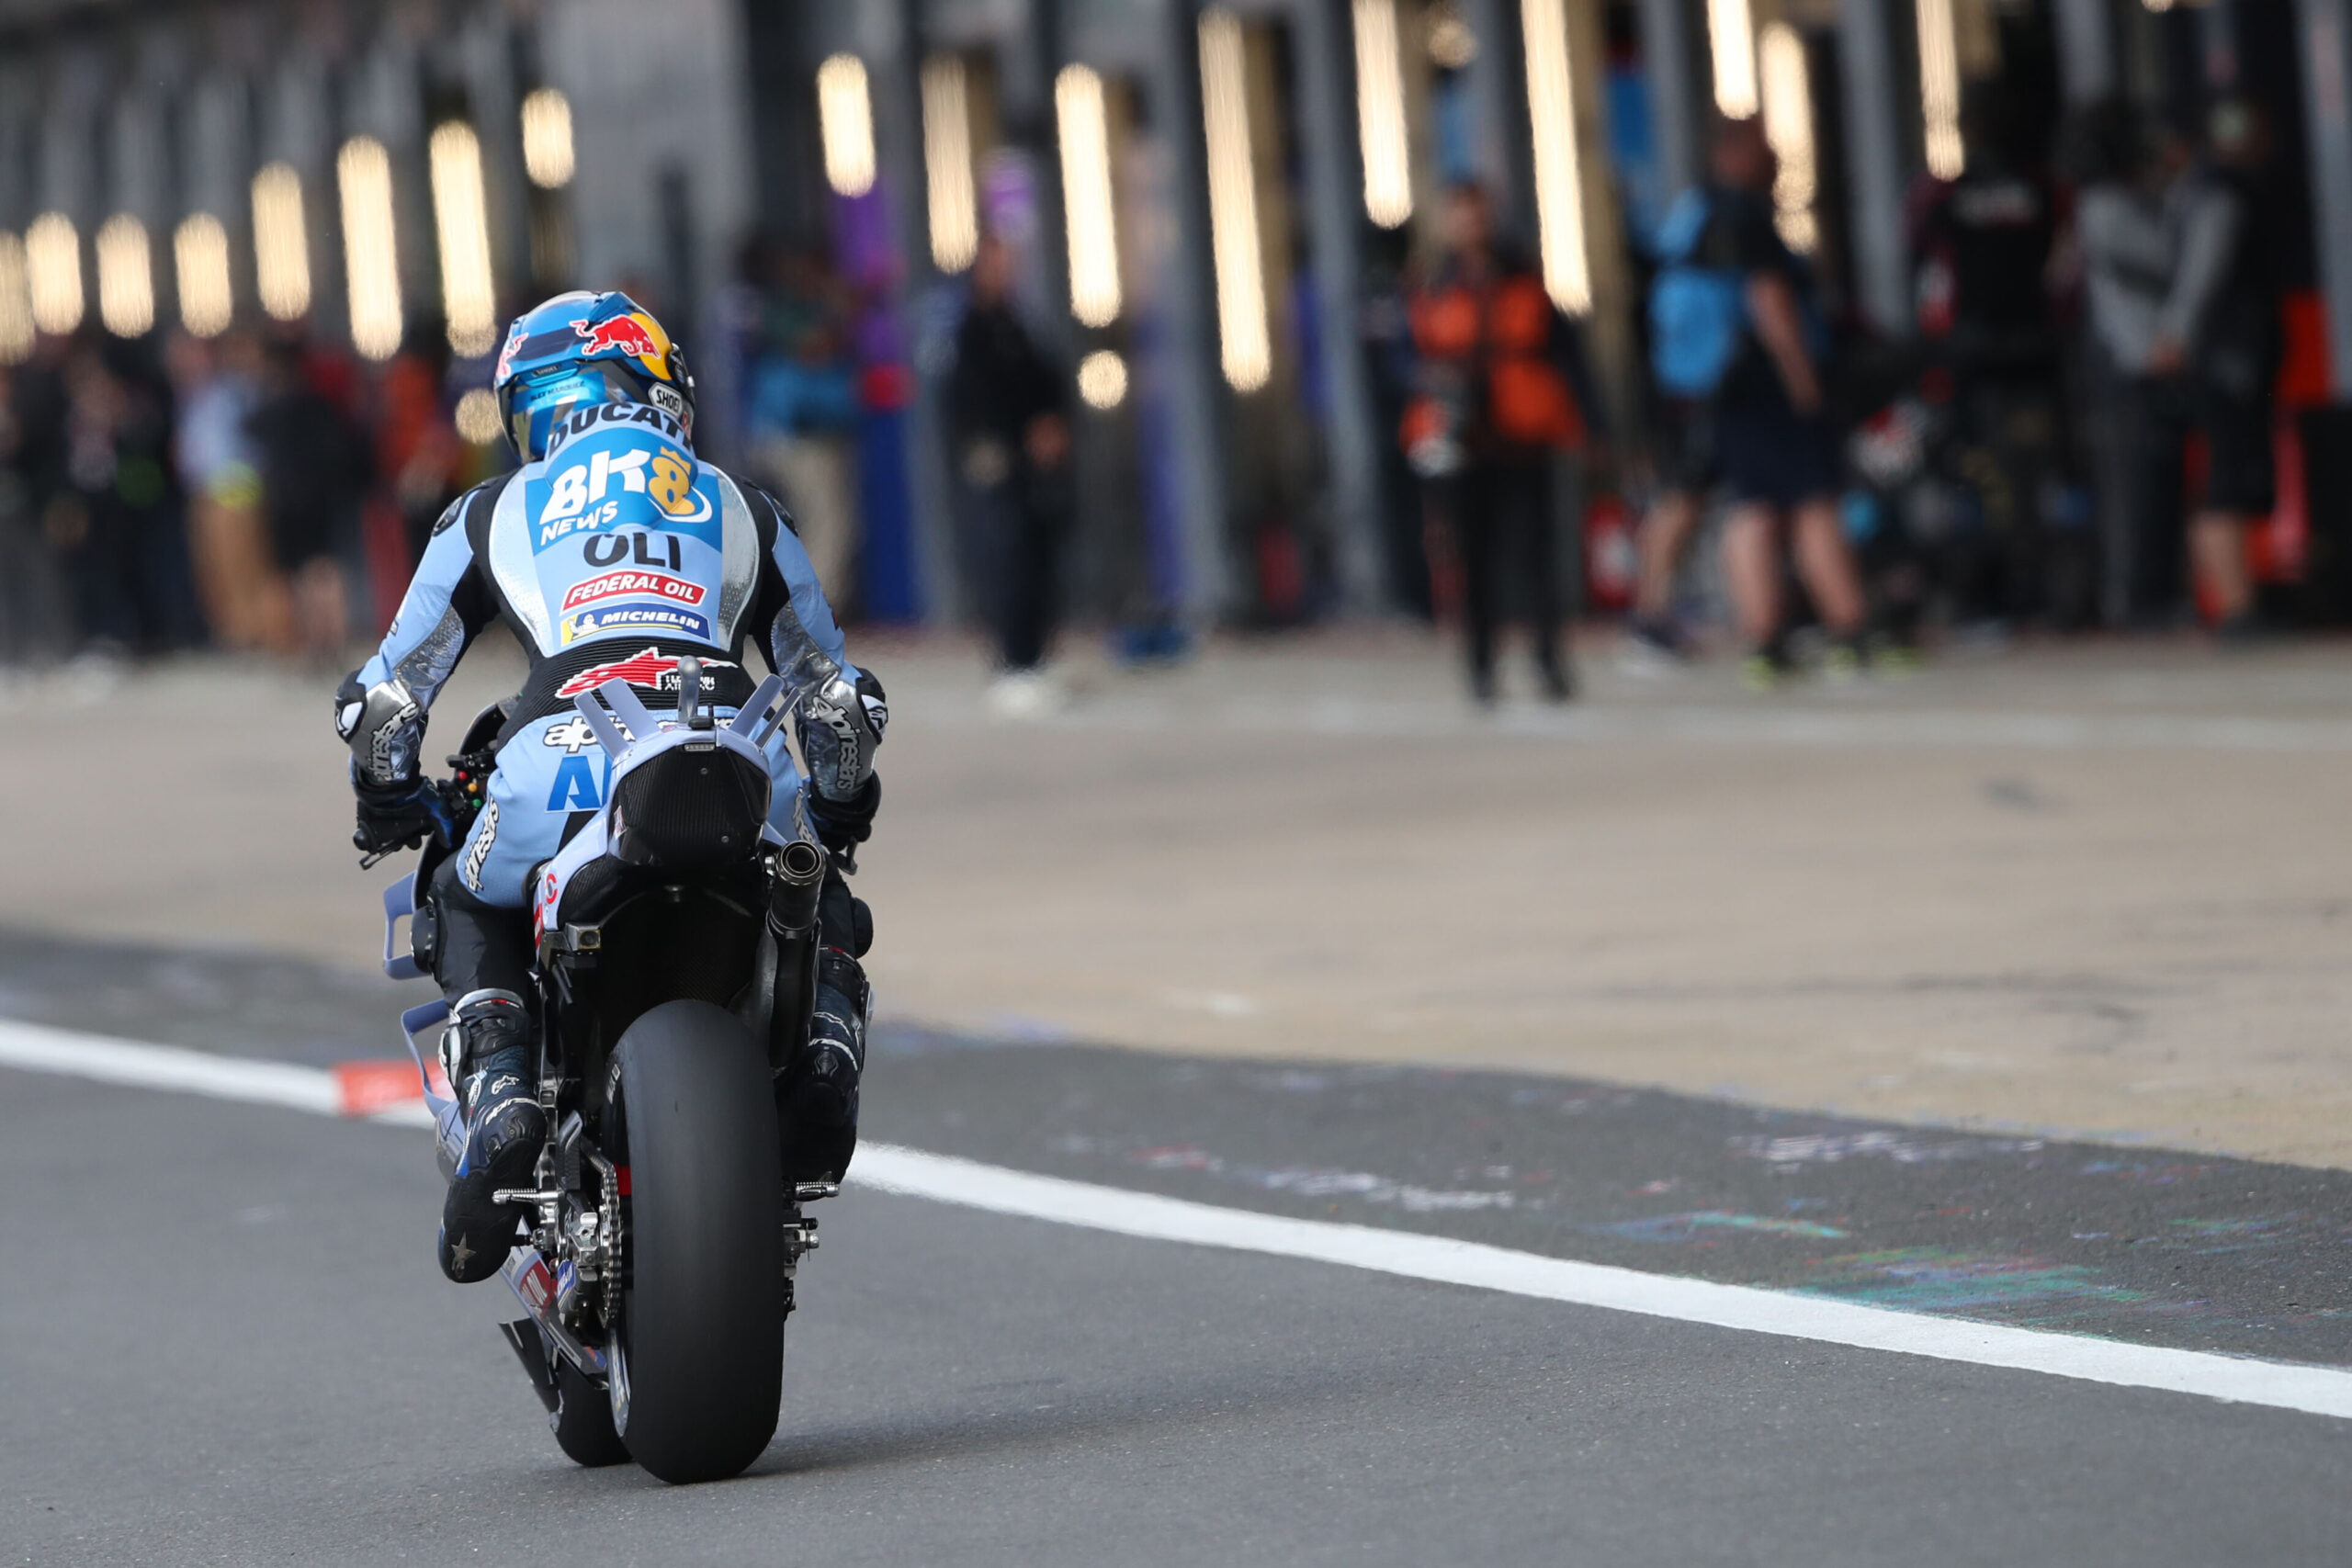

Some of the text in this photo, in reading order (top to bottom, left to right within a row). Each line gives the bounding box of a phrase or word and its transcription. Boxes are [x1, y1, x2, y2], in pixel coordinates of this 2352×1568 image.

[656, 389, 680, 412] SHOEI
[540, 501, 619, 546] NEWS
[583, 532, 681, 572] OLI
[568, 575, 695, 604] FEDERAL OIL
[601, 611, 700, 630] MICHELIN
